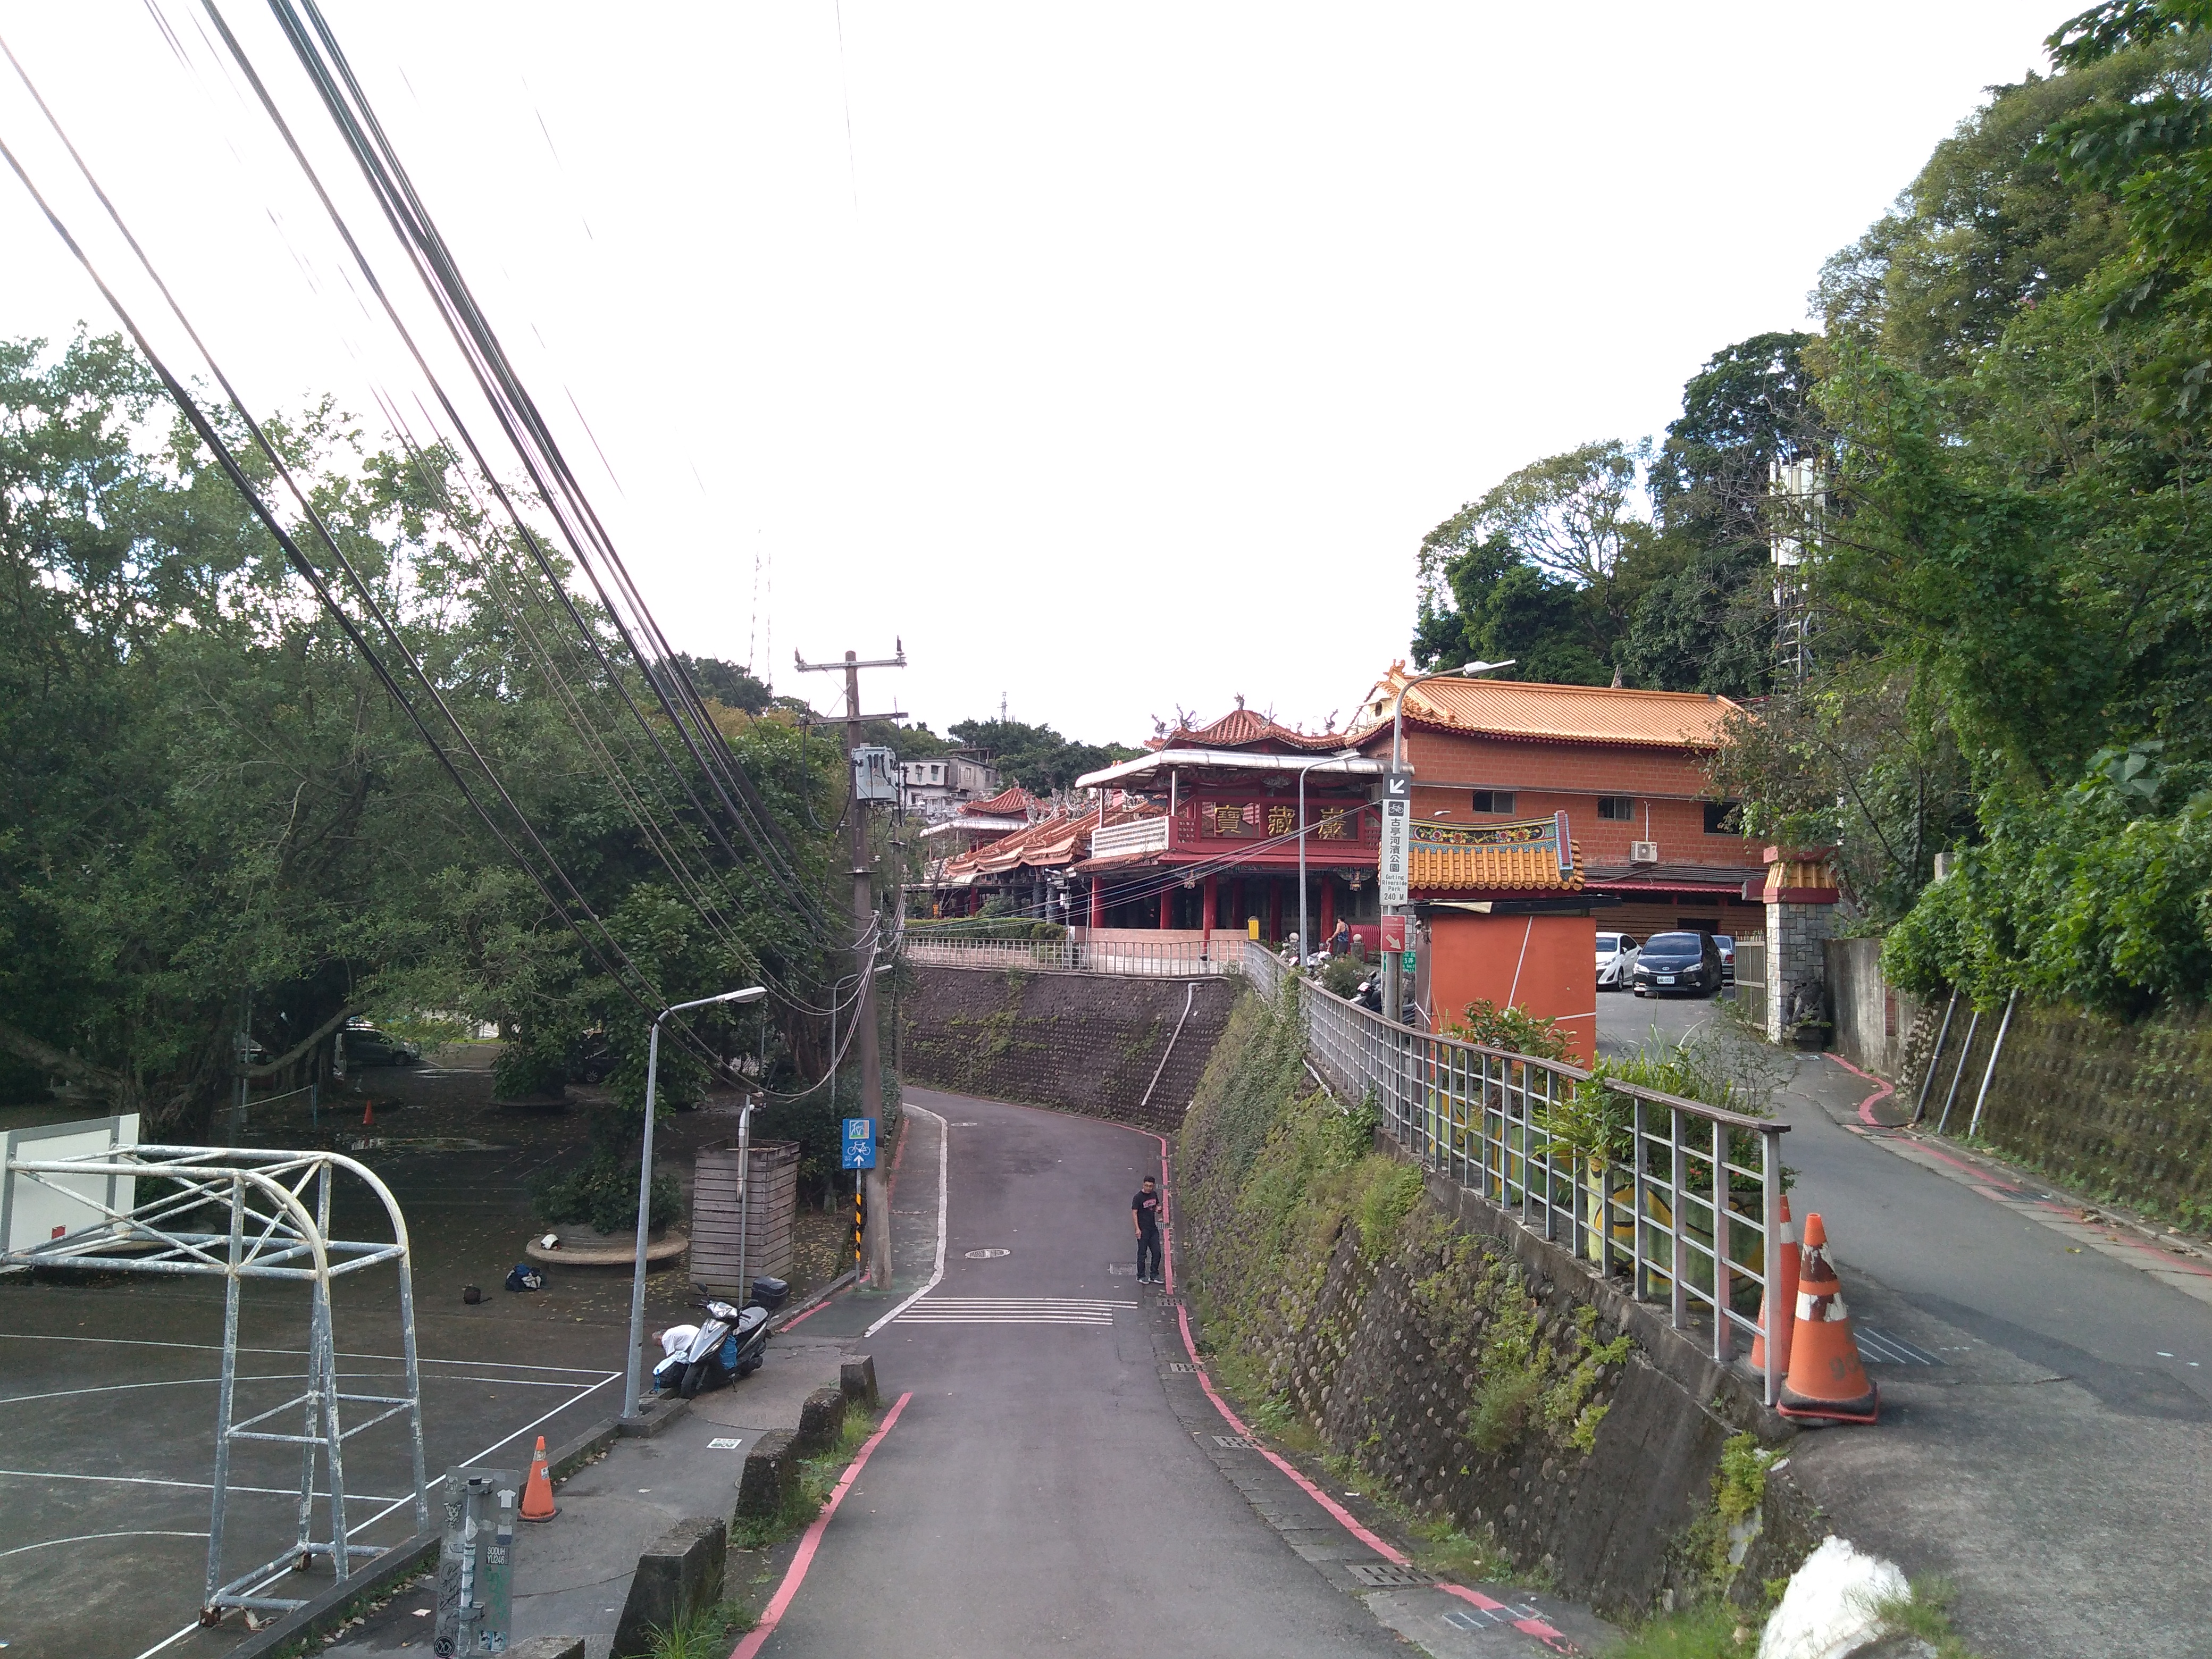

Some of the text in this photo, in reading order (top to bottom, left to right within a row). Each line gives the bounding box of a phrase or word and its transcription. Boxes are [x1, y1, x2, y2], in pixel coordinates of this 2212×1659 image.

[1389, 818, 1401, 873] 古亭河濱公園
